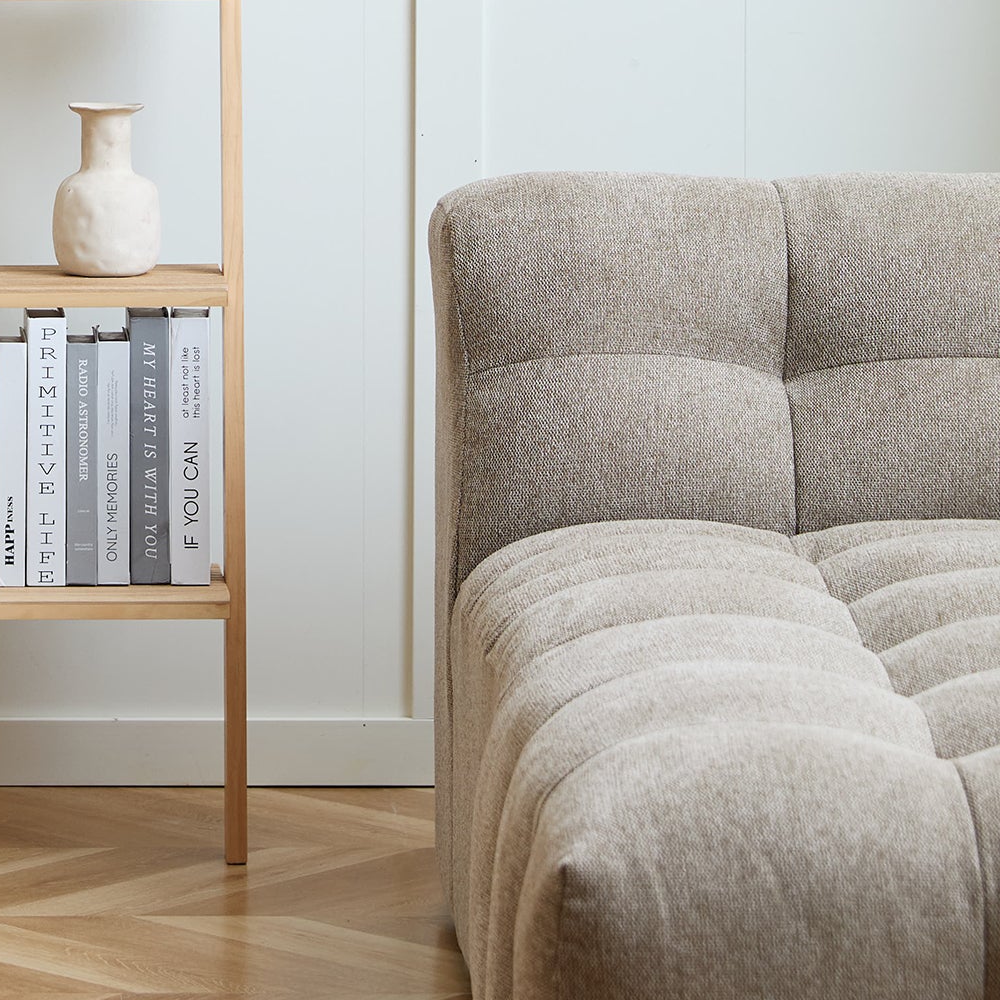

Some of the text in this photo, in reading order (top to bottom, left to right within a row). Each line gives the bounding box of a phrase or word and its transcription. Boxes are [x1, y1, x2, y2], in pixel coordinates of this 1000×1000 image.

[181, 347, 189, 362] like
[38, 328, 57, 584] PRIMITIVE LIFE
[78, 359, 89, 482] RADIO ASTRONOMER
[143, 342, 158, 560] MY HEART IS WITH YOU
[182, 409, 189, 419] at
[106, 453, 118, 523] MEMORIES
[183, 442, 199, 549] IF YOU CAN
[106, 526, 118, 562] ONLY
